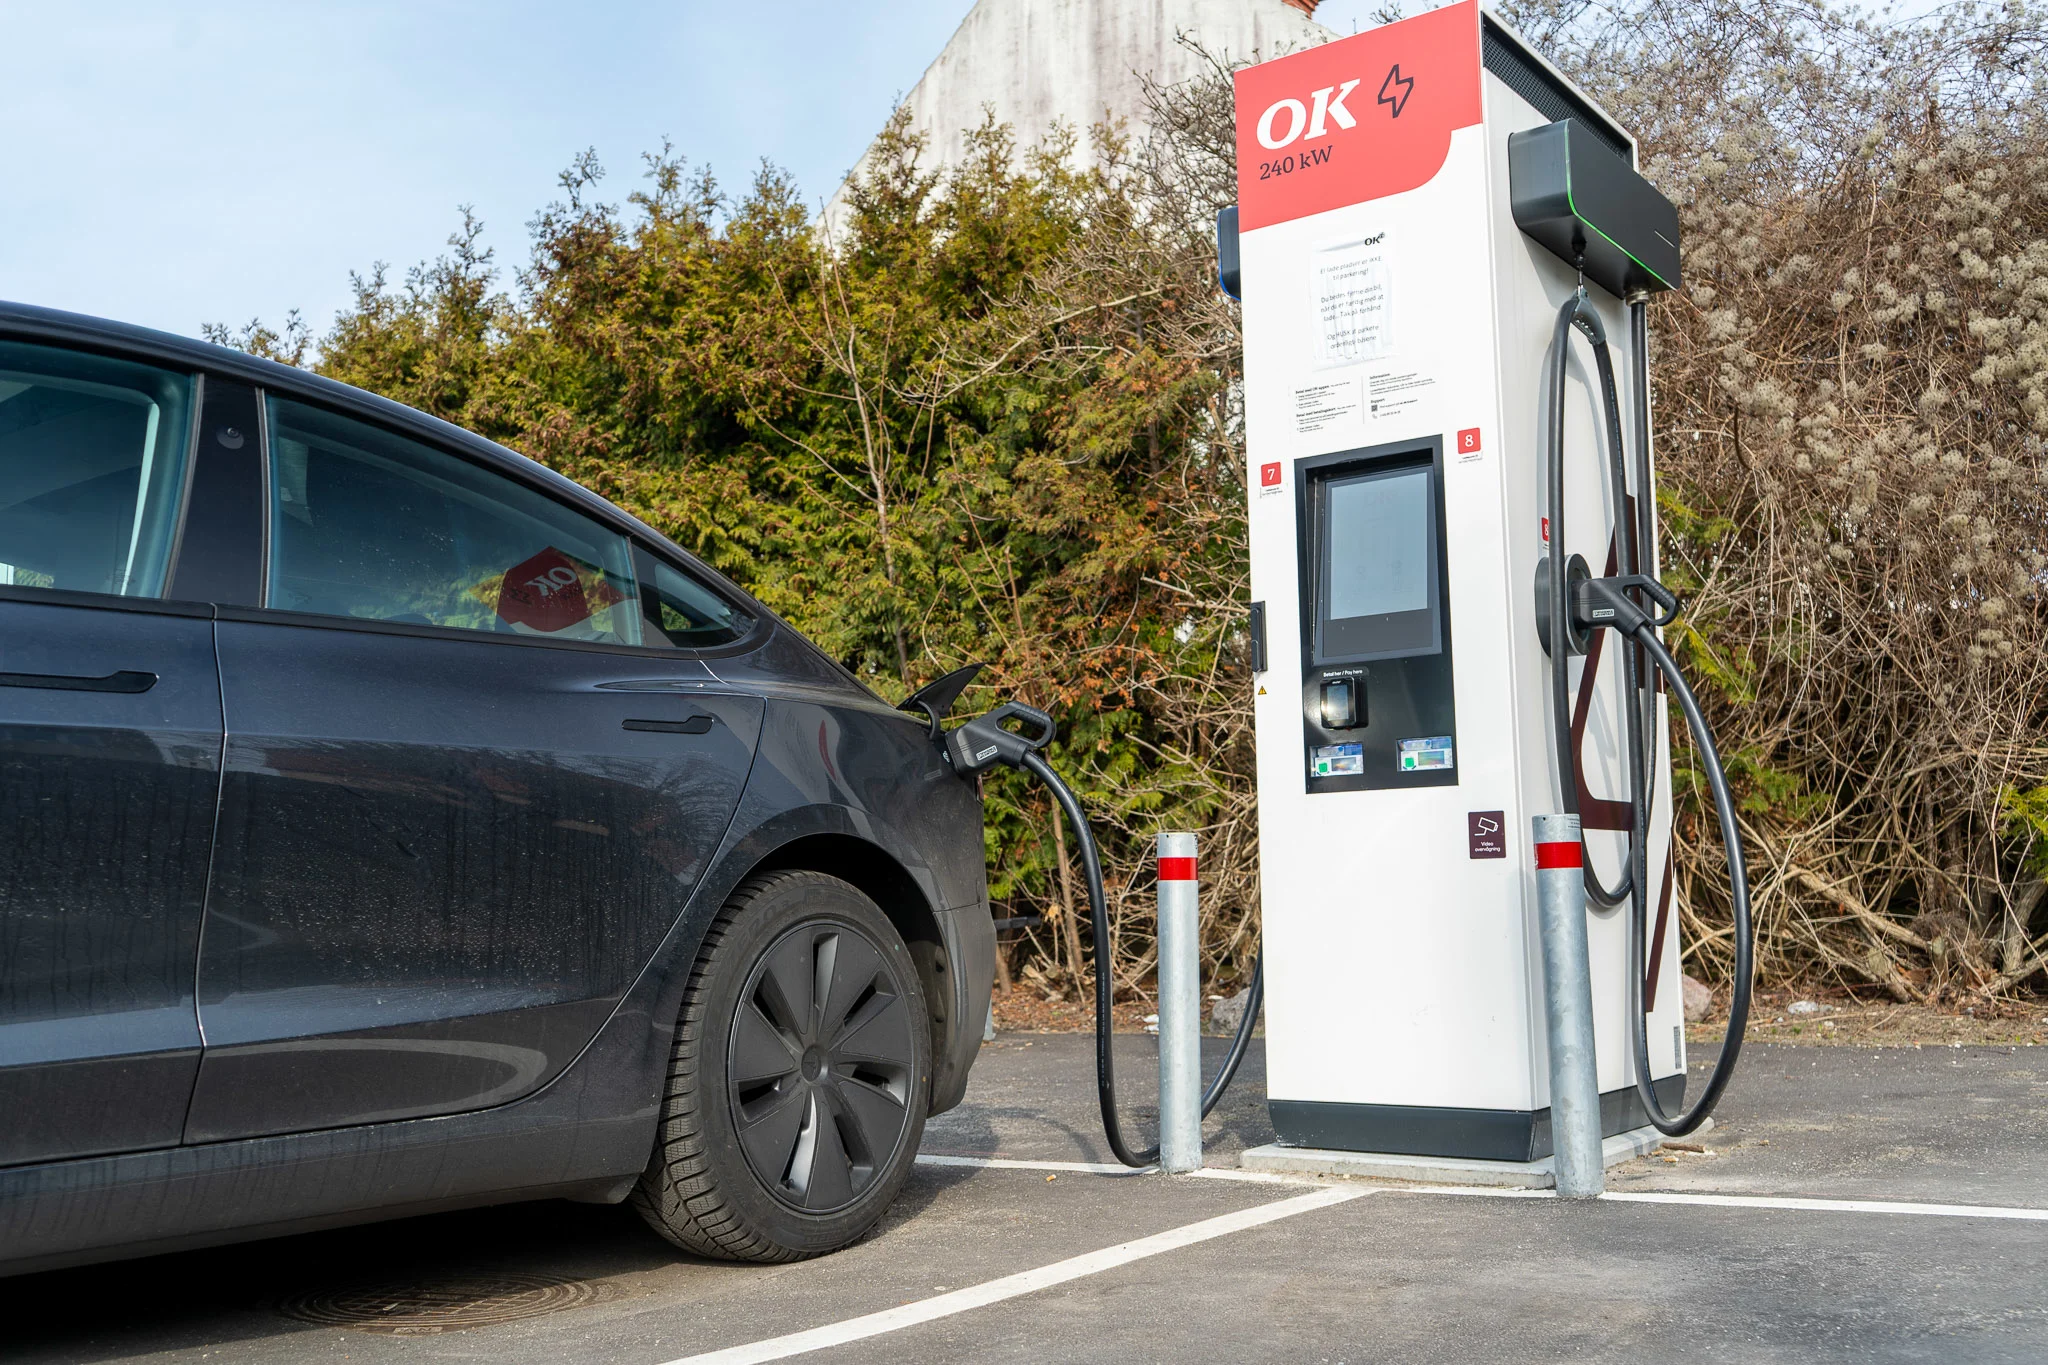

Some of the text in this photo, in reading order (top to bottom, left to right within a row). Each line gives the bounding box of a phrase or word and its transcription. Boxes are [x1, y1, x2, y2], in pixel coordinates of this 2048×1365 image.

[1256, 78, 1361, 150] OK
[1260, 145, 1333, 181] 240 kW
[1465, 434, 1474, 447] 8
[1267, 468, 1275, 480] 7
